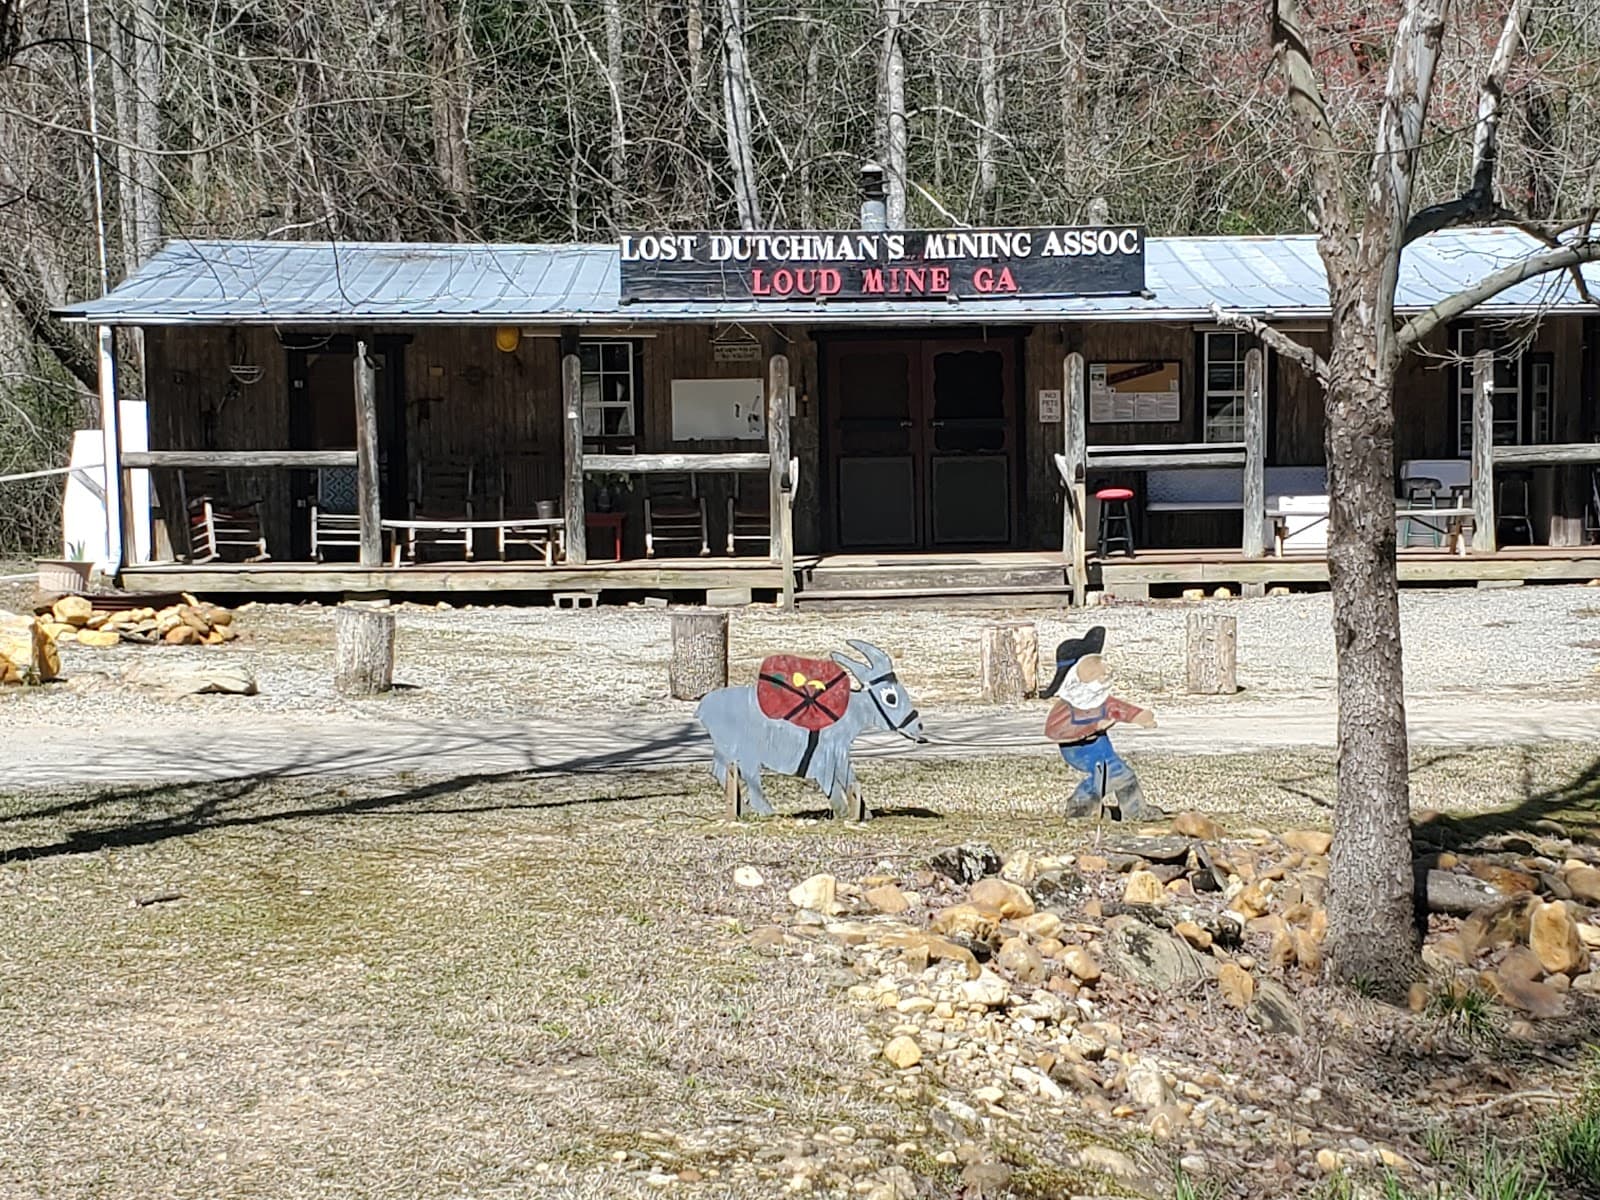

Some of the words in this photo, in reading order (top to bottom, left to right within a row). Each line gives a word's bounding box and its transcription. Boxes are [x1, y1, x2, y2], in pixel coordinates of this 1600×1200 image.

[621, 235, 697, 260] LOST
[710, 233, 905, 261] DUTCHMAN'S
[924, 233, 1031, 259] MINING
[752, 268, 841, 295] LOUD
[862, 267, 949, 293] MINE
[973, 266, 1018, 292] GA
